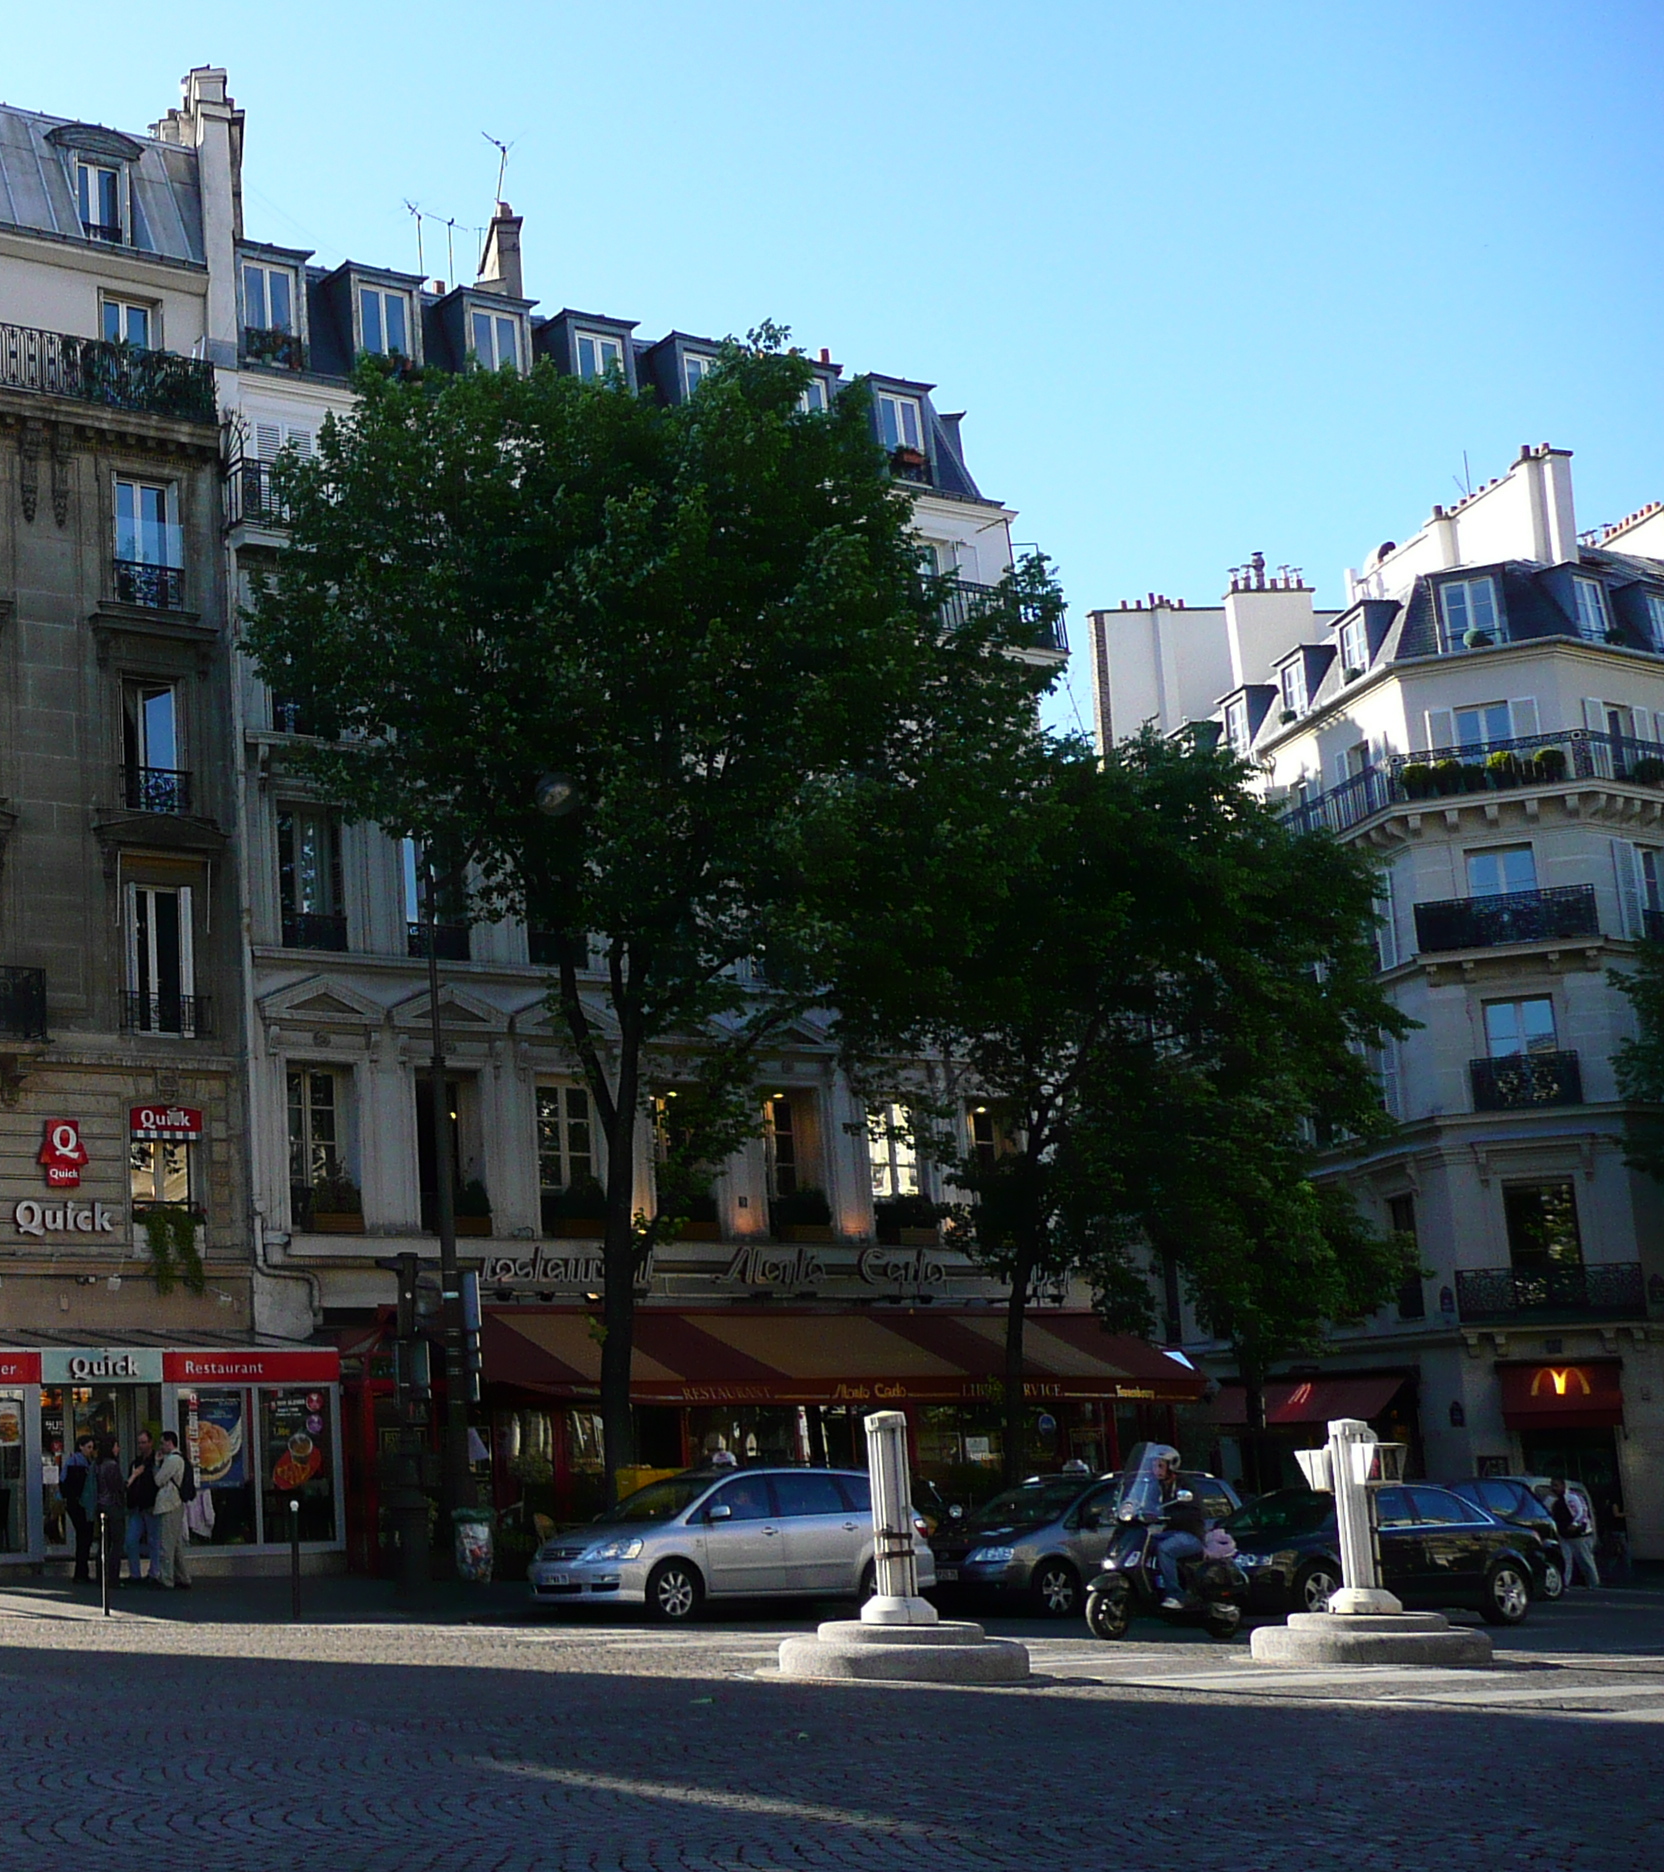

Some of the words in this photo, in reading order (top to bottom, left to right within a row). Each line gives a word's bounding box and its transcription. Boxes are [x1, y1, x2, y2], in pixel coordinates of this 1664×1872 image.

[140, 1109, 191, 1129] Quik
[52, 1125, 80, 1159] Q
[49, 1168, 79, 1180] Quick
[16, 1200, 113, 1236] Quick
[857, 1248, 946, 1285] Carlo
[70, 1354, 139, 1380] Quick
[185, 1360, 263, 1374] Restaurant
[681, 1386, 772, 1401] RESTAURANT
[874, 1381, 907, 1398] Carlo
